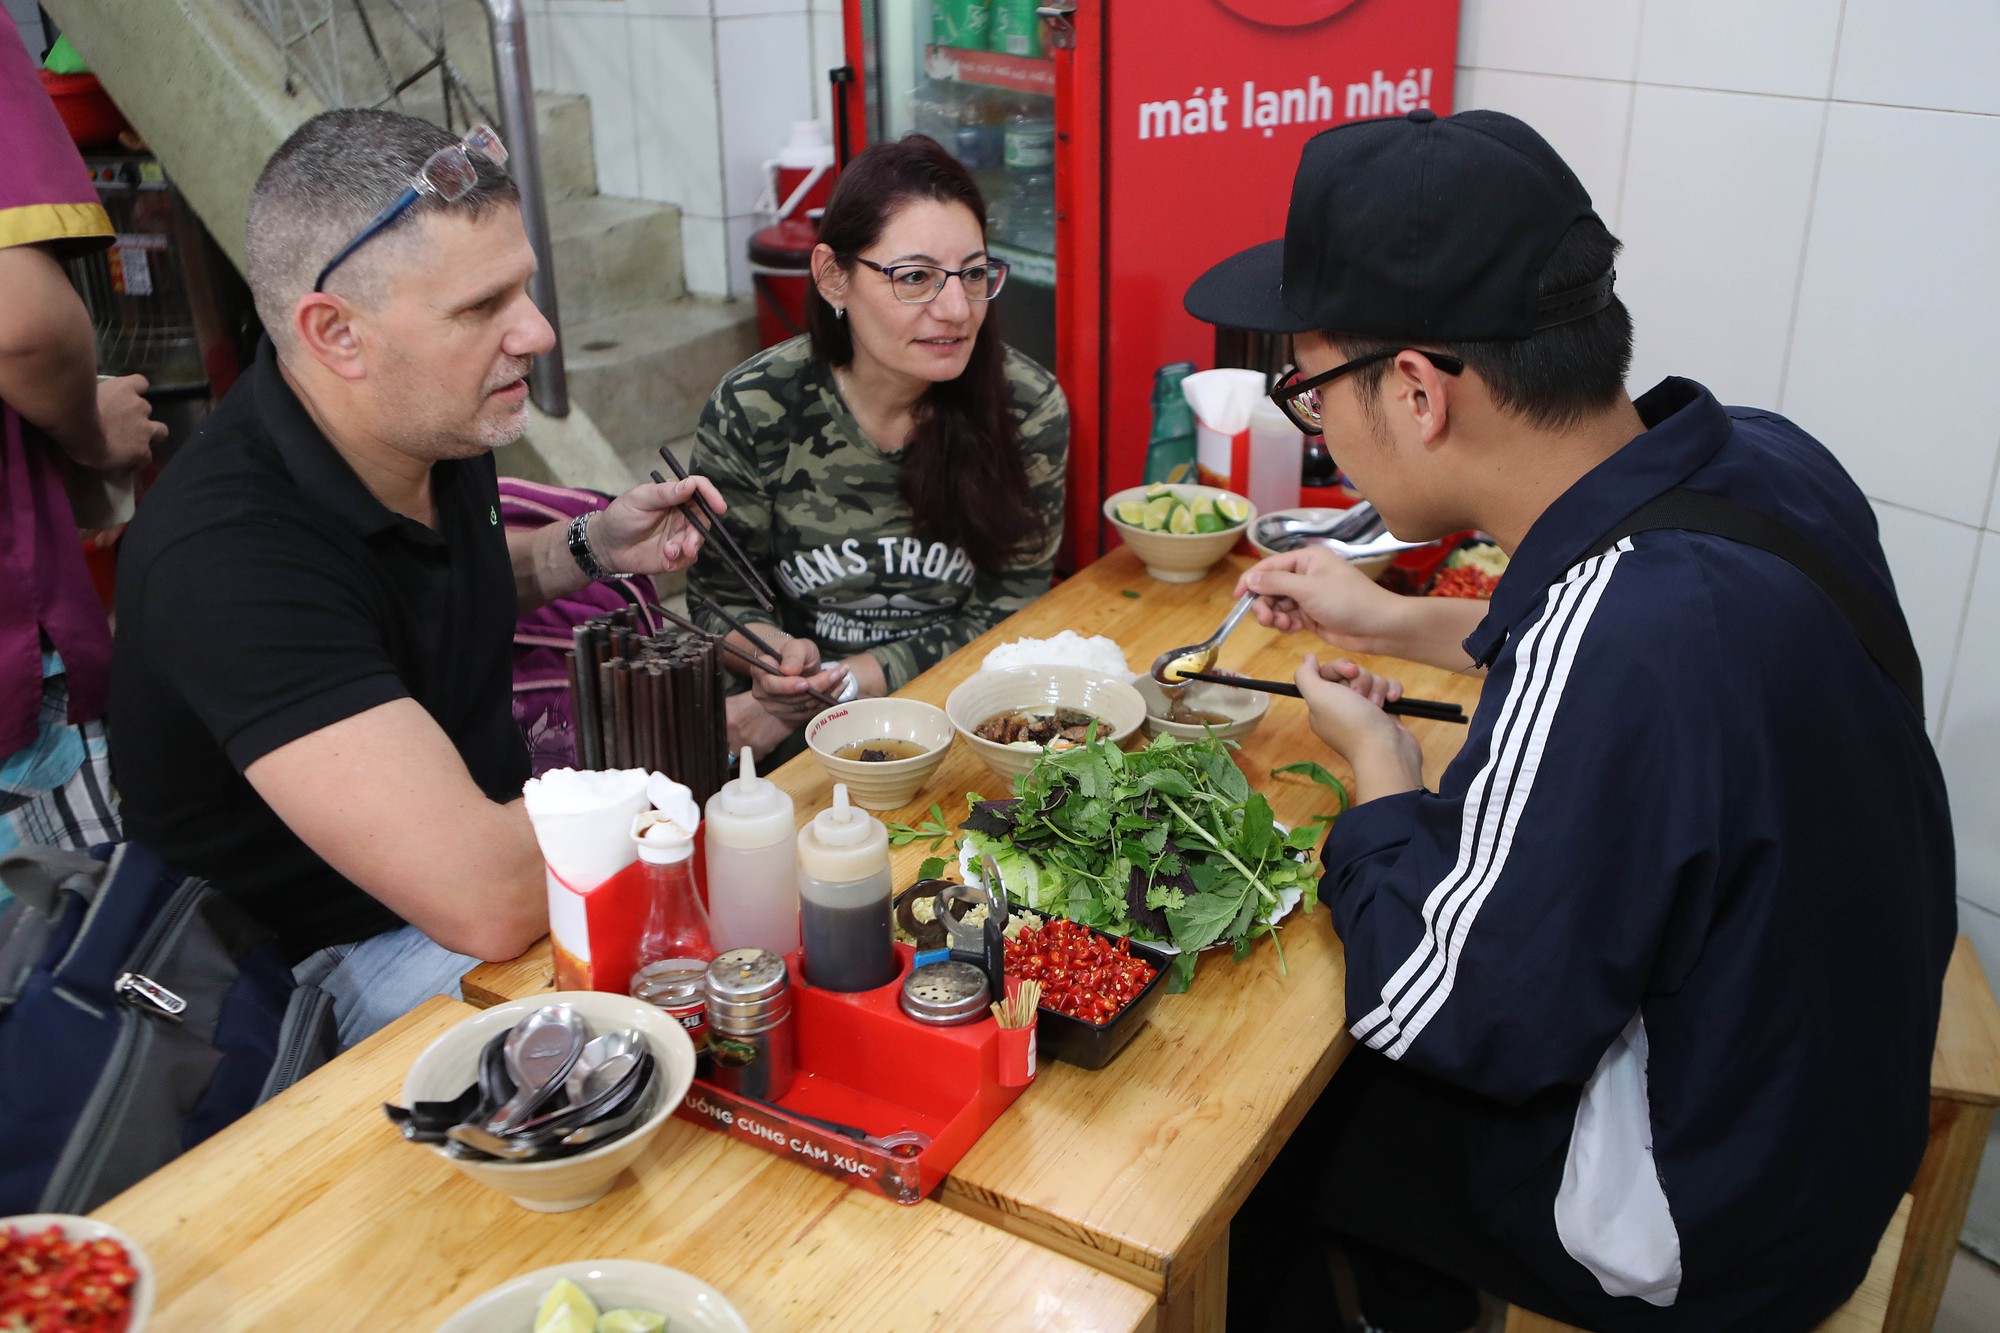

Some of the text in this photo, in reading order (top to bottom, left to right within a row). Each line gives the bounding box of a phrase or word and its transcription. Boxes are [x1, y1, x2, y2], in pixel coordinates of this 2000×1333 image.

[1139, 68, 1432, 139] mát lạnh nhé!
